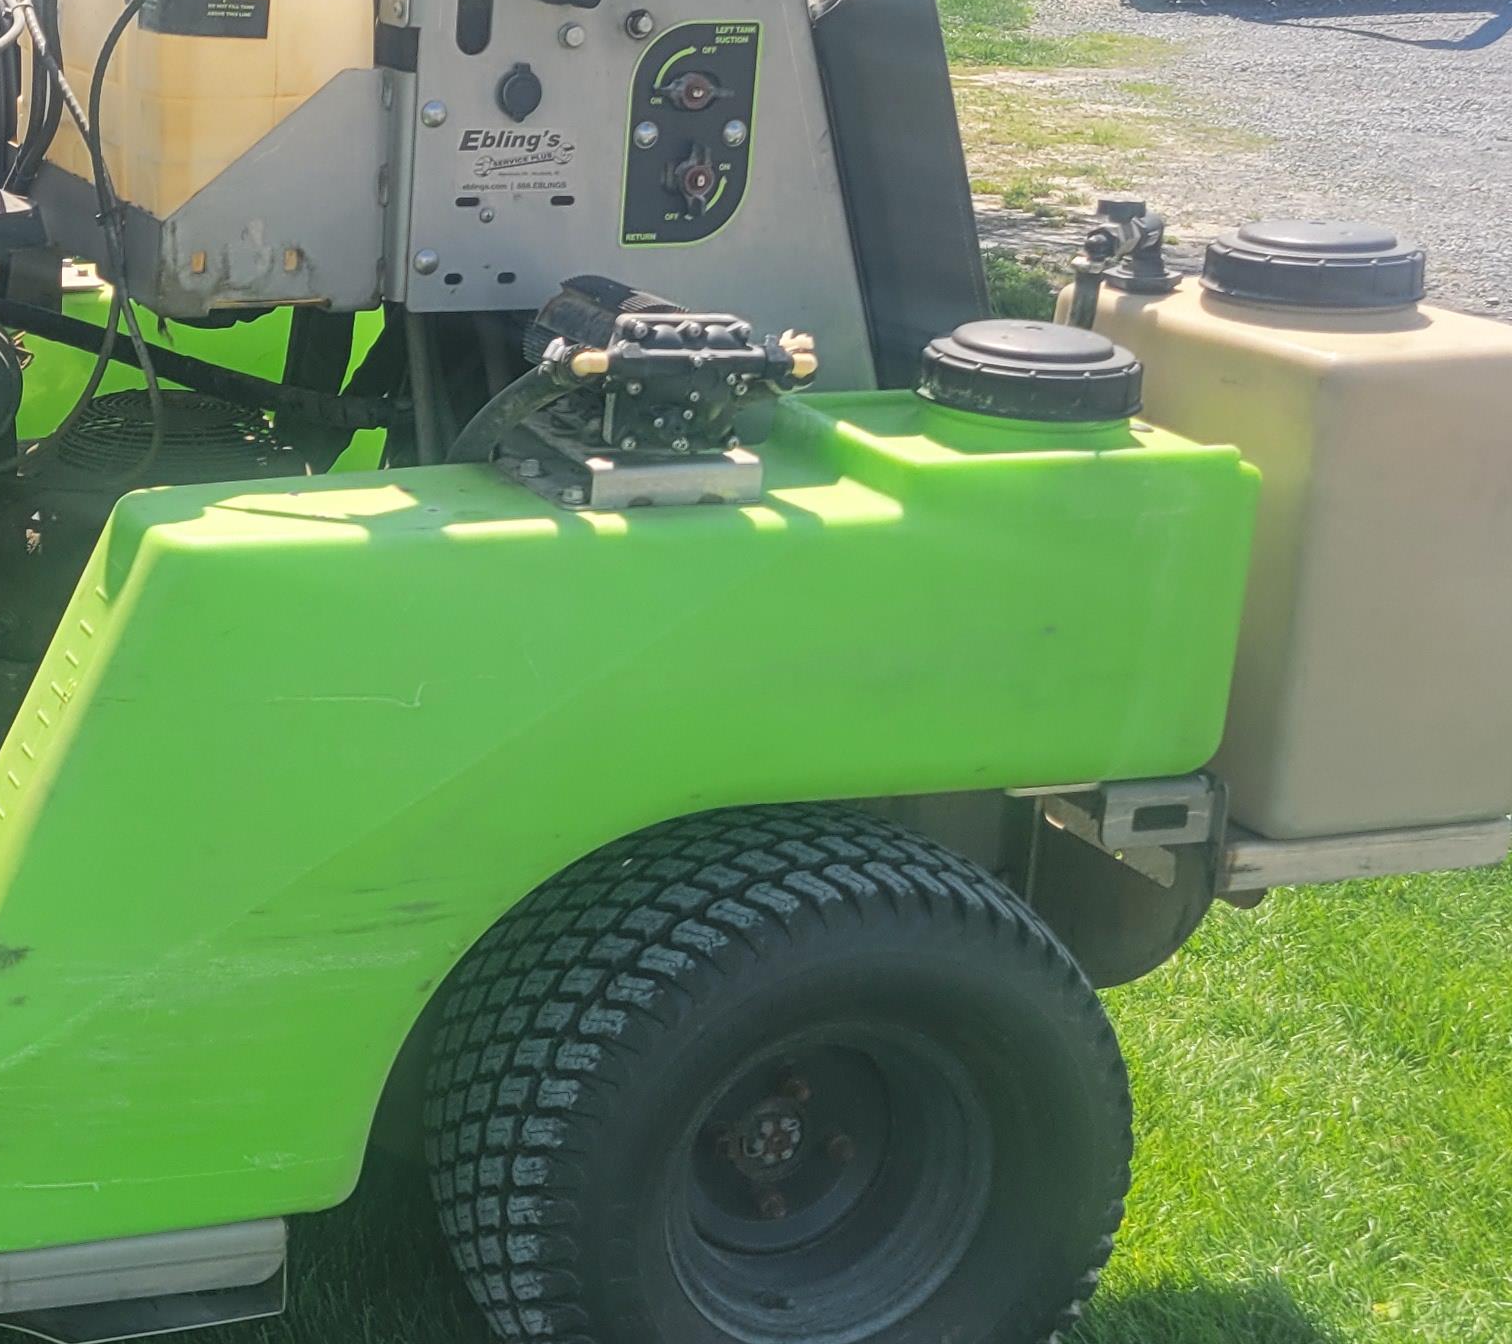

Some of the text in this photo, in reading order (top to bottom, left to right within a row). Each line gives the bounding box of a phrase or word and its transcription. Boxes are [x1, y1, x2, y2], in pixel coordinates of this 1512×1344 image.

[715, 26, 756, 34] LEFT TANK
[715, 36, 749, 44] SUCTION
[702, 46, 718, 54] OFF
[650, 97, 662, 105] ON
[458, 129, 562, 153] Ebling's
[493, 152, 553, 167] SERVICE PLUS
[719, 163, 731, 171] ON
[462, 183, 508, 192] eblings.com
[664, 213, 679, 221] OFF
[625, 233, 656, 241] RETURN
